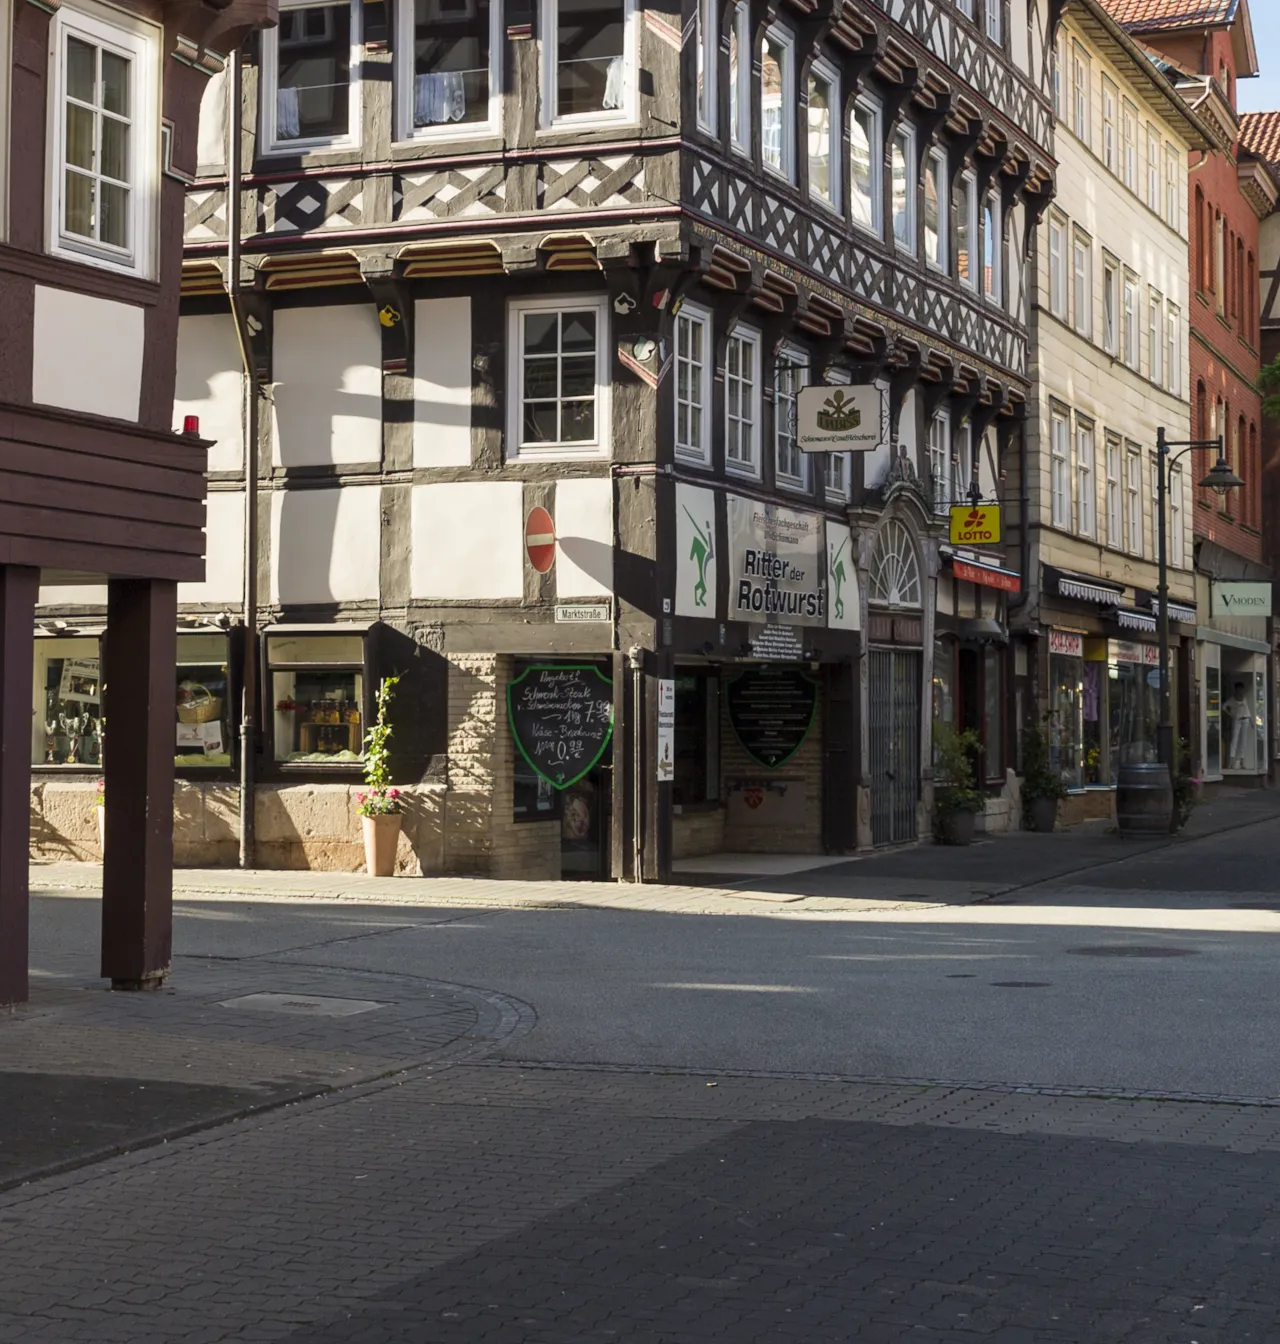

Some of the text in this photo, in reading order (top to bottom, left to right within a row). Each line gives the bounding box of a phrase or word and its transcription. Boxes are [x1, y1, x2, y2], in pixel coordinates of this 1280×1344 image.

[958, 531, 992, 540] LOTTO
[744, 549, 805, 581] Ritter der
[737, 579, 823, 617] Rotwurst
[562, 609, 601, 619] Marktstraße
